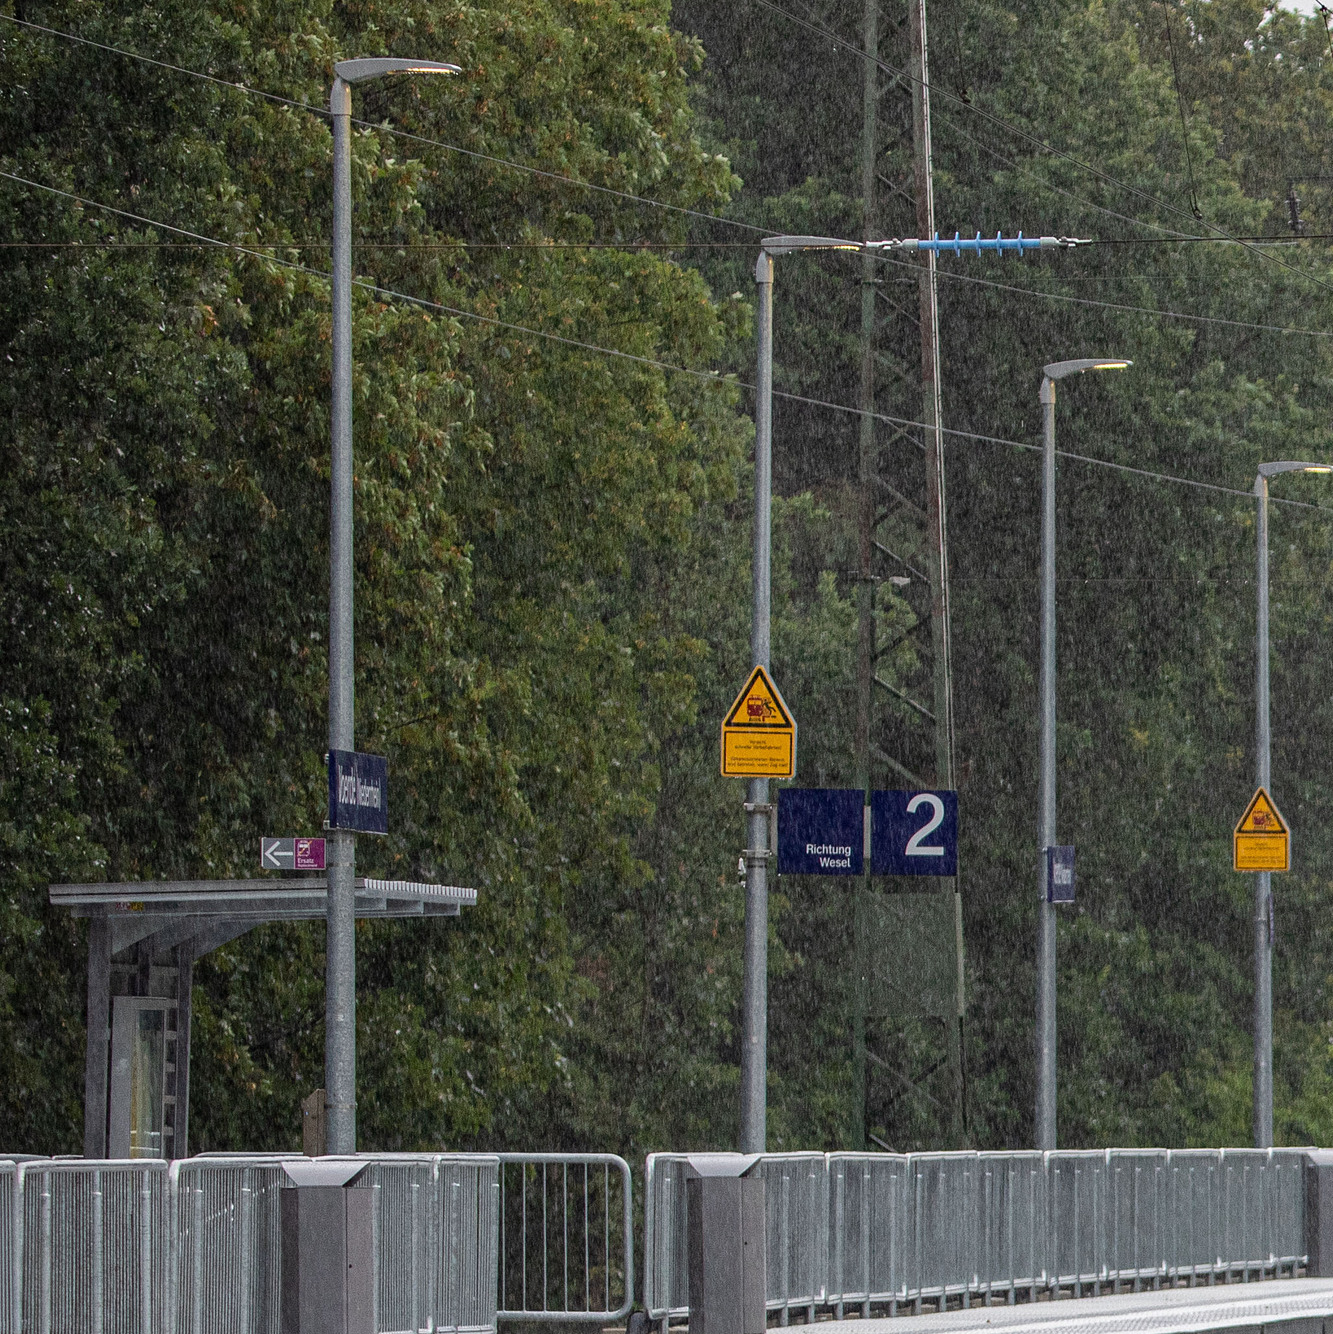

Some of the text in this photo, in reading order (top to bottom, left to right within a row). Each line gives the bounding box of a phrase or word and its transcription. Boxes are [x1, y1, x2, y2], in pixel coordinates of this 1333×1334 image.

[905, 793, 945, 856] 2
[806, 843, 852, 857] Richtung
[819, 857, 851, 868] Wesel
